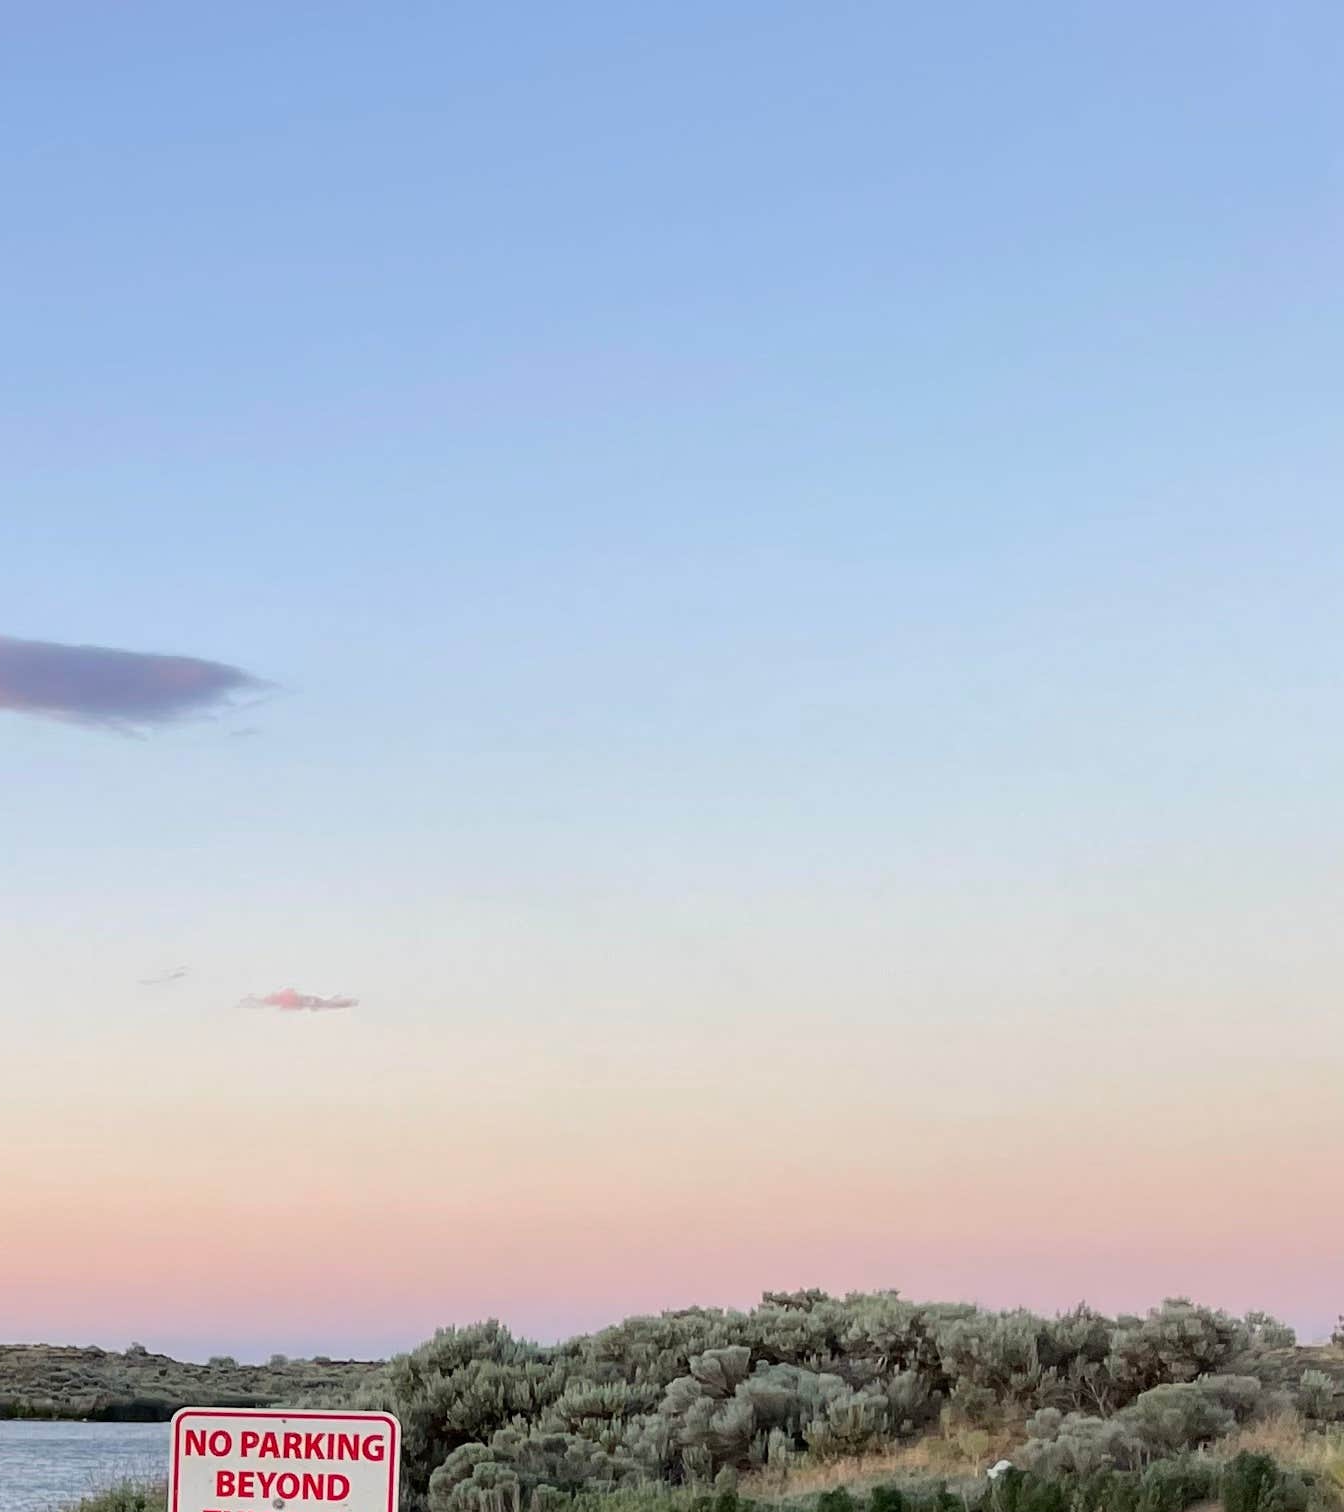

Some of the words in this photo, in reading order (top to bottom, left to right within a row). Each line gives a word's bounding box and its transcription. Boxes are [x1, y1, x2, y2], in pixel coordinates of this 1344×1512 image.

[185, 1430, 232, 1457] NO
[240, 1431, 385, 1462] PARKING
[215, 1470, 350, 1501] BEYOND
